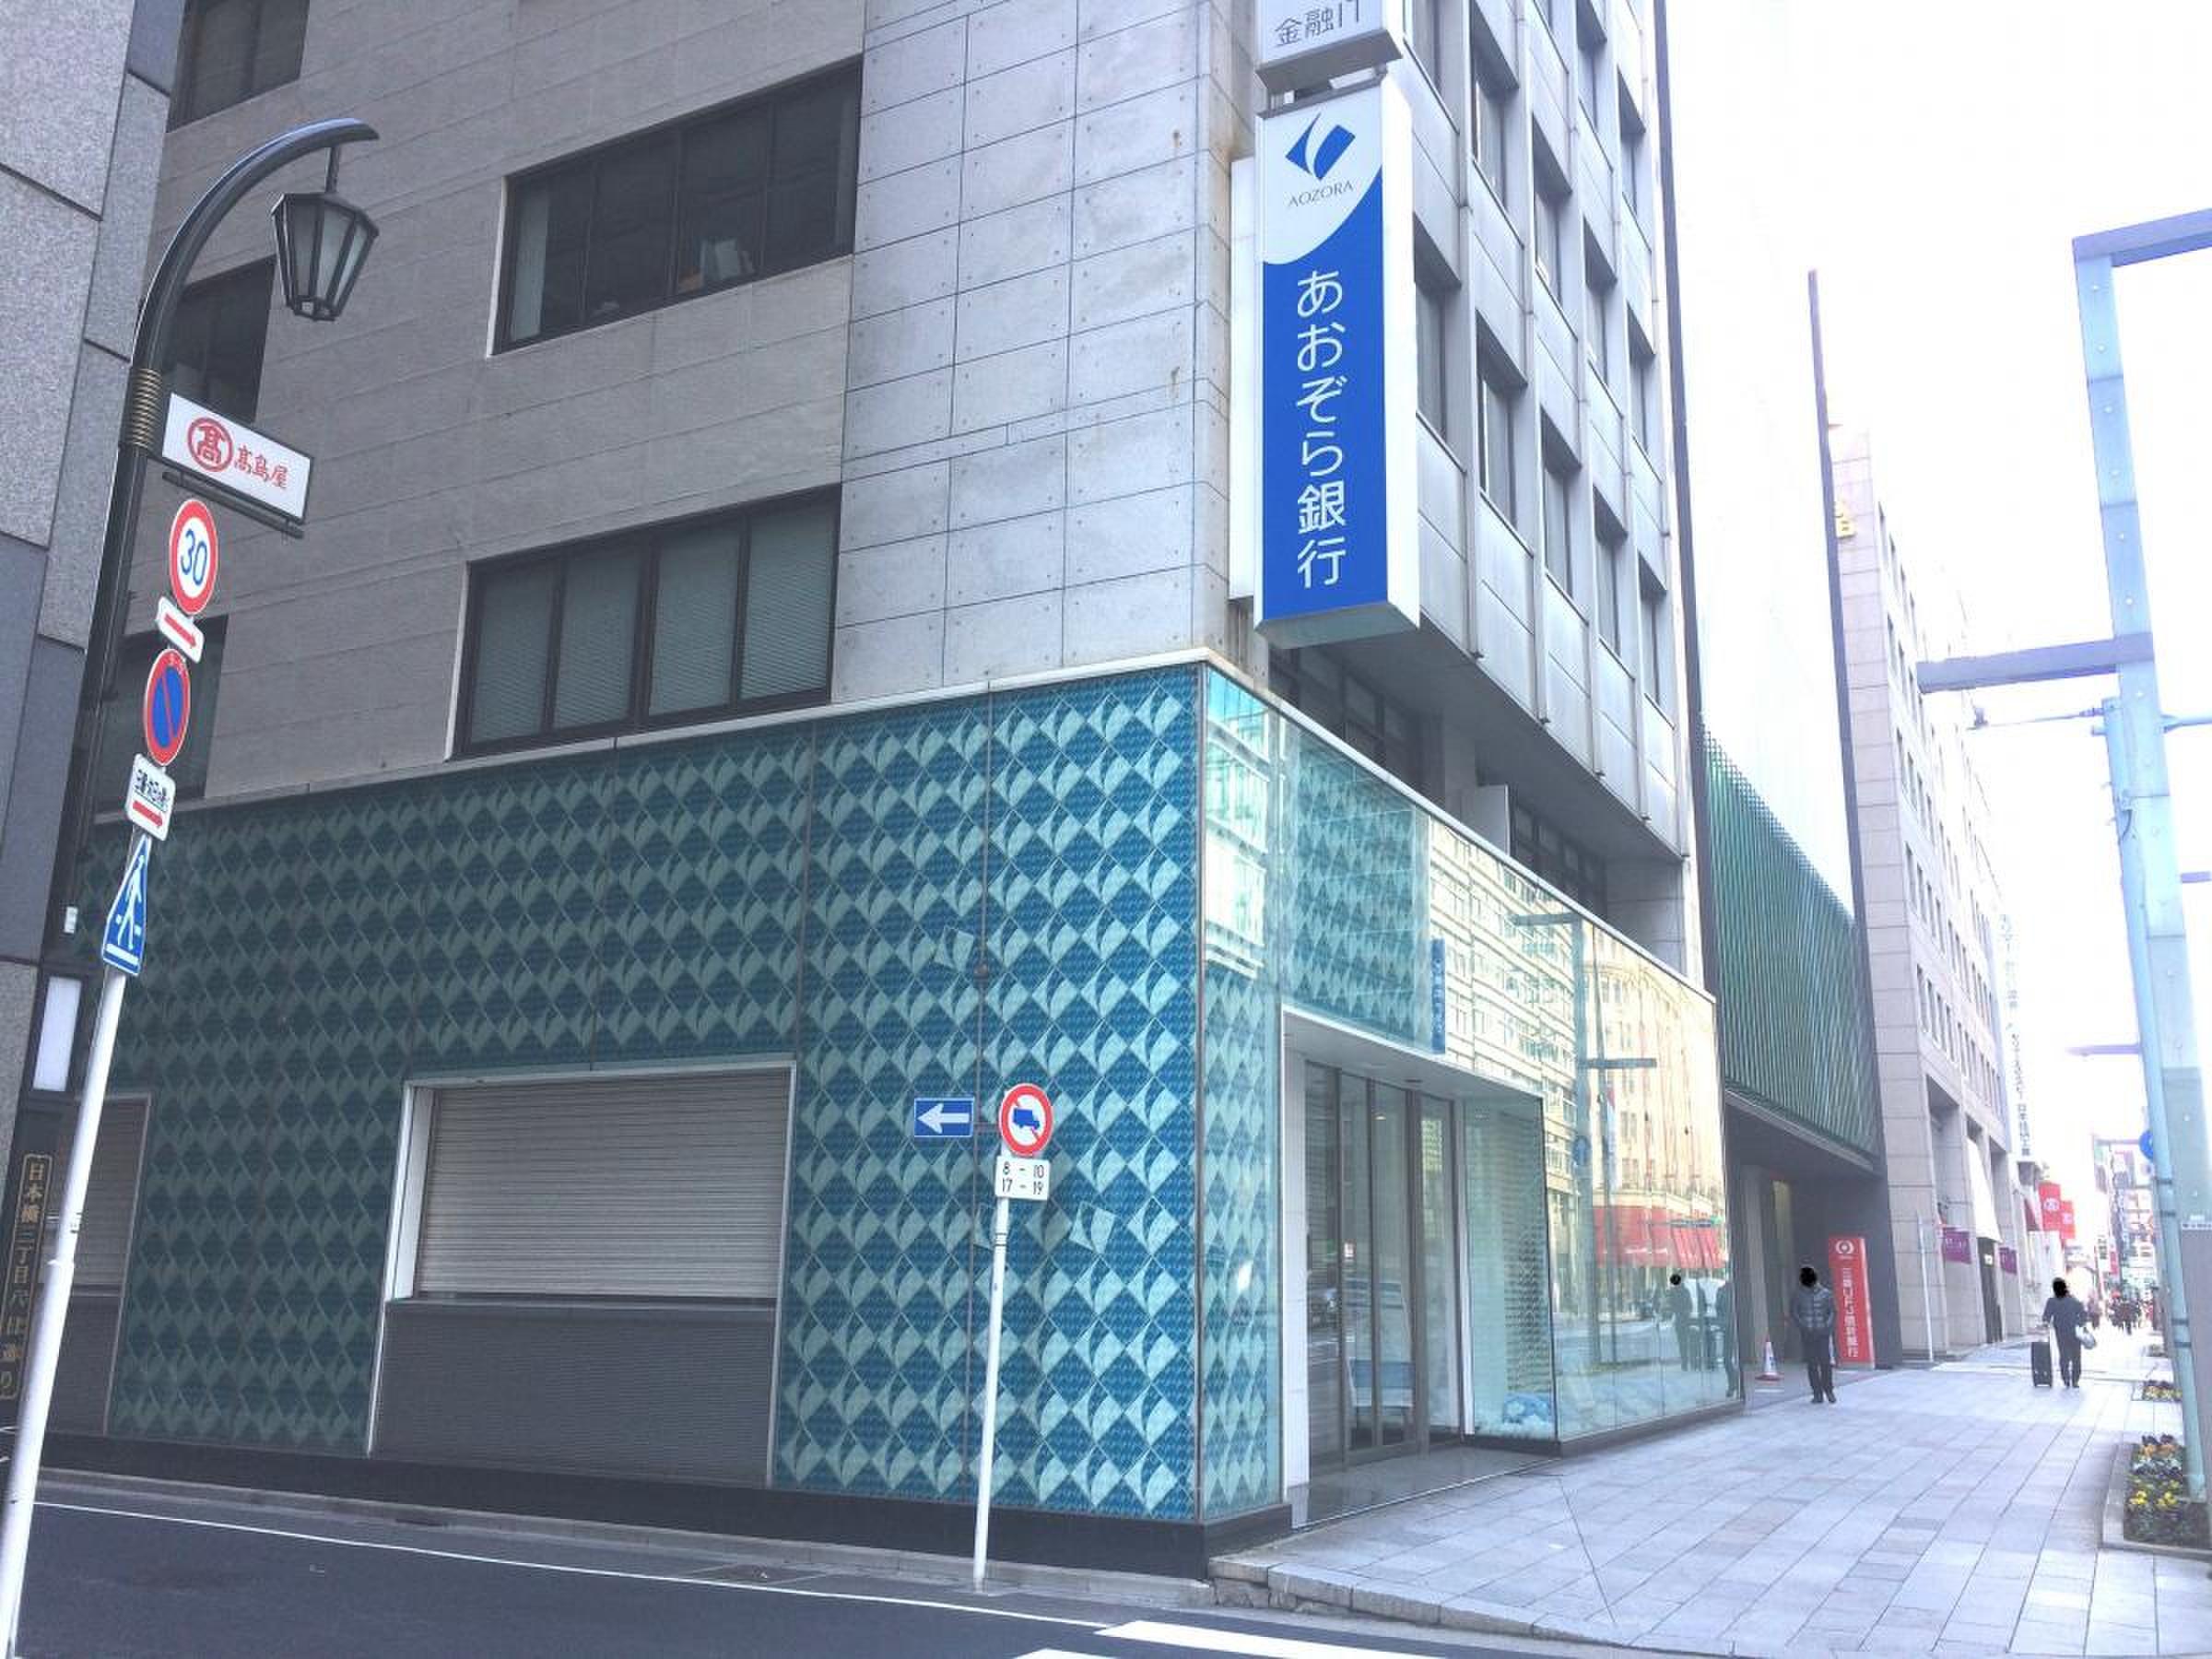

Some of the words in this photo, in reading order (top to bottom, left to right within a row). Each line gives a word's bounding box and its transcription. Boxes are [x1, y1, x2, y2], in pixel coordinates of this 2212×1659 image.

[1288, 180, 1354, 207] AOZORA
[1296, 268, 1347, 590] あおぞら銀行
[180, 530, 207, 587] 30
